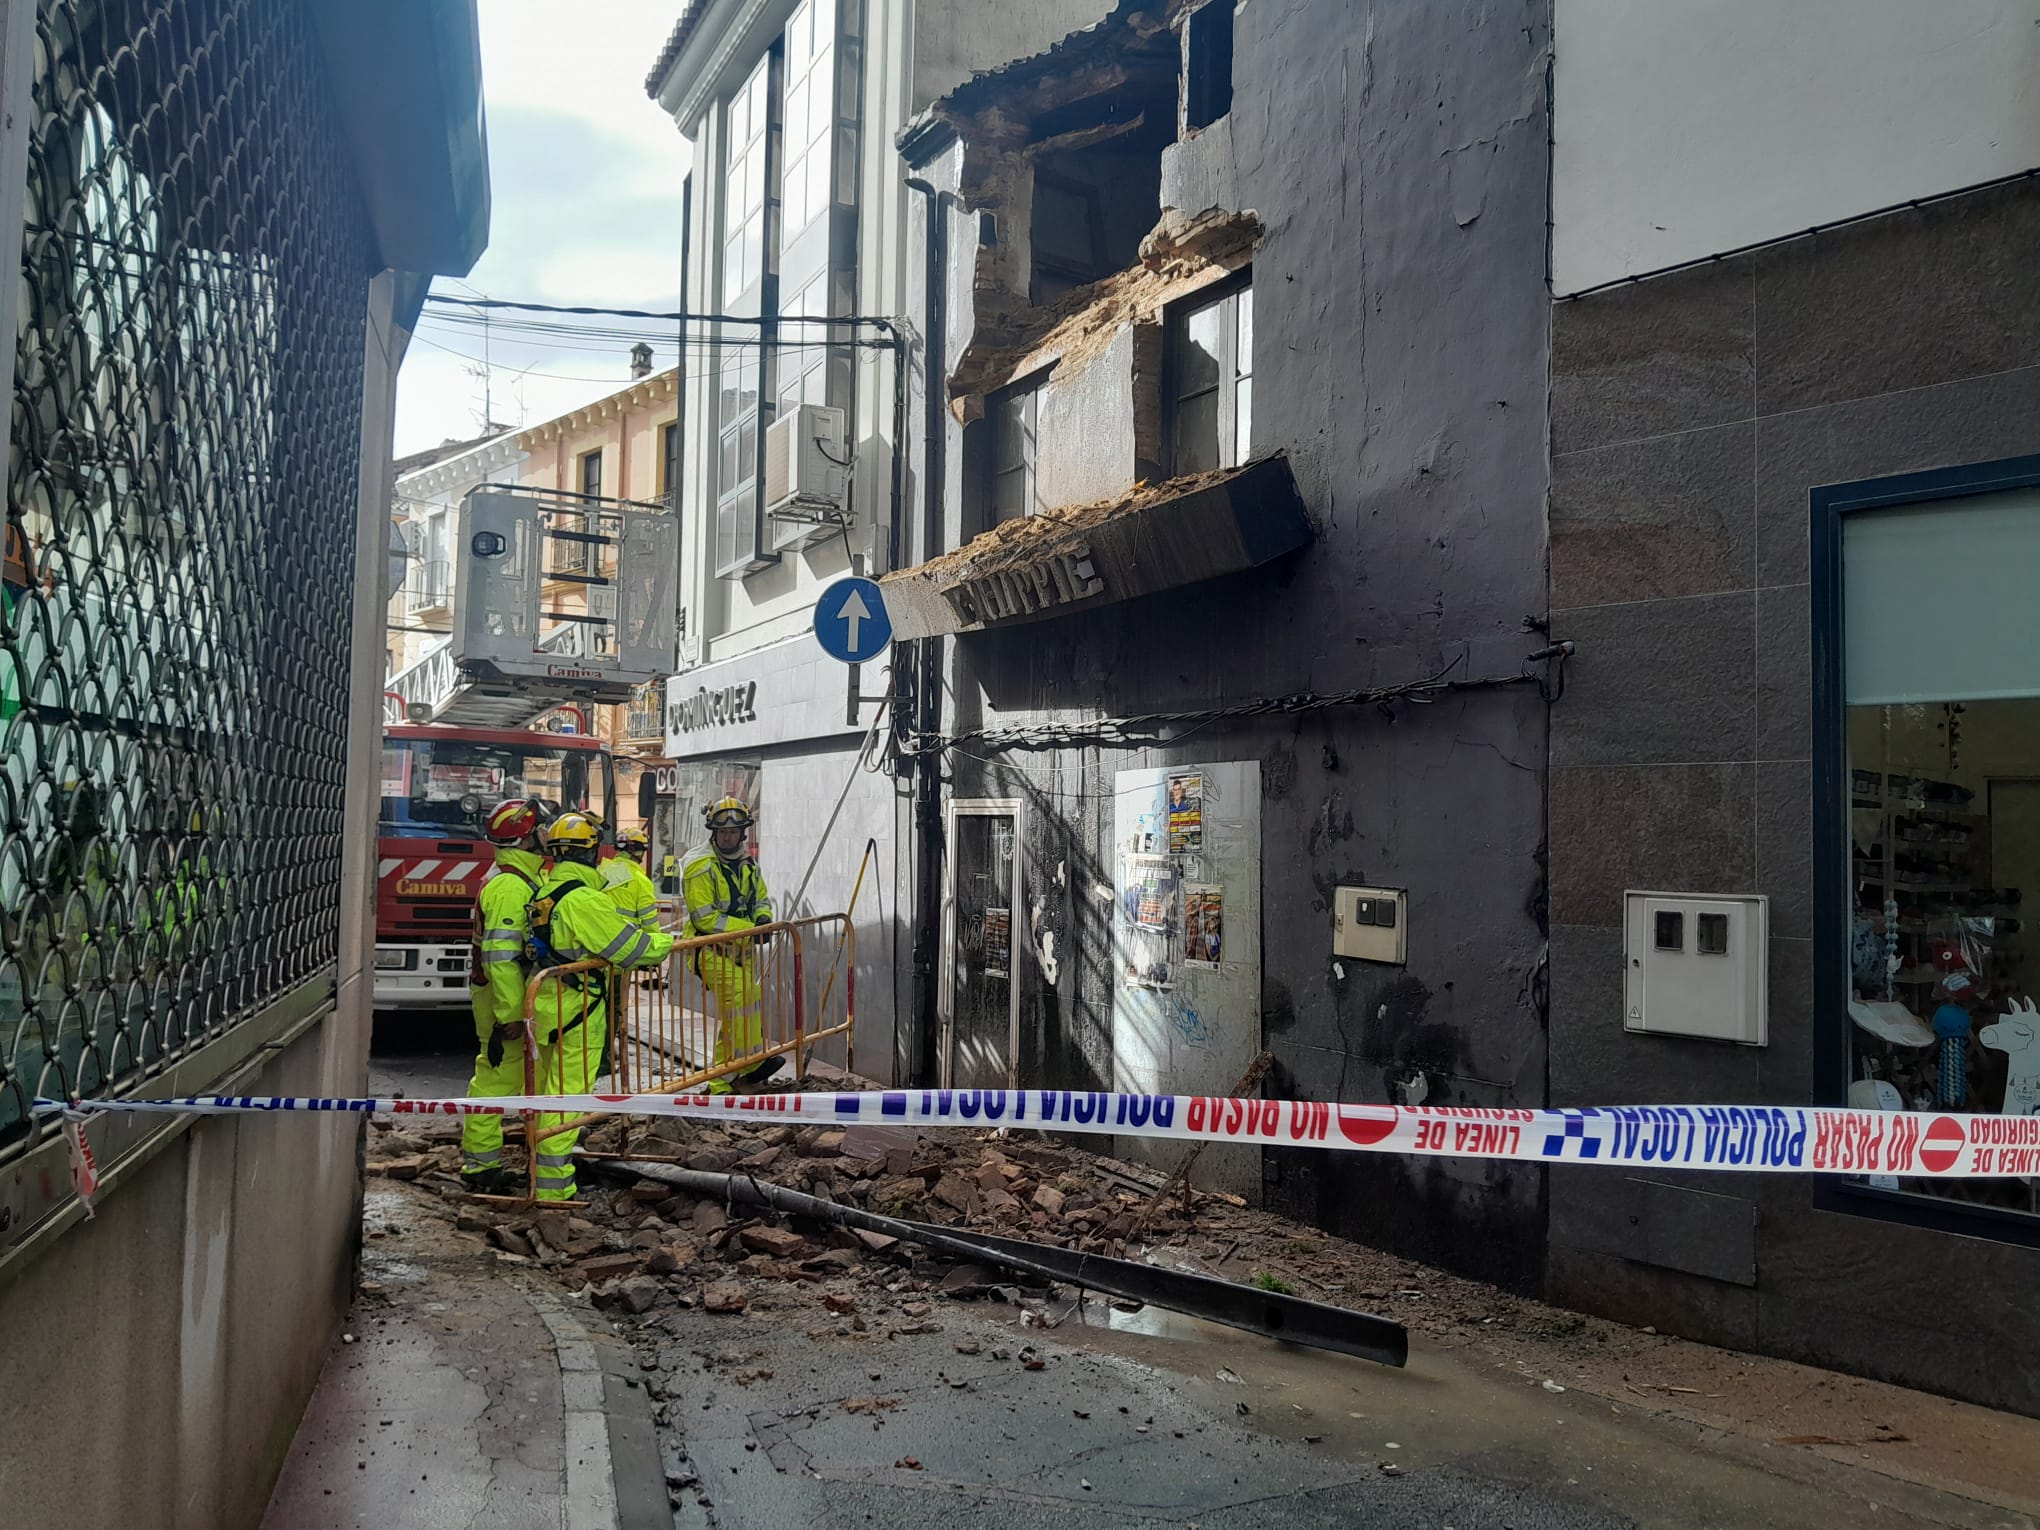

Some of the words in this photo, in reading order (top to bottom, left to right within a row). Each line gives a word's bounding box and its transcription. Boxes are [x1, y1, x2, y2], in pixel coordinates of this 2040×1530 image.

[547, 664, 602, 679] Camiva
[396, 880, 467, 895] Camiva
[1290, 1102, 1330, 1141] NO
[1414, 1120, 1446, 1150] DE
[1602, 1107, 1698, 1164] LOCAL
[1704, 1107, 1807, 1167] POLICIA
[1970, 1118, 2040, 1146] GURIDAD
[1455, 1122, 1520, 1155] LINEA
[1812, 1111, 1885, 1170] PASAR
[1887, 1114, 1920, 1171] NO
[1970, 1148, 1995, 1174] DE
[1998, 1148, 2040, 1173] LINEA
